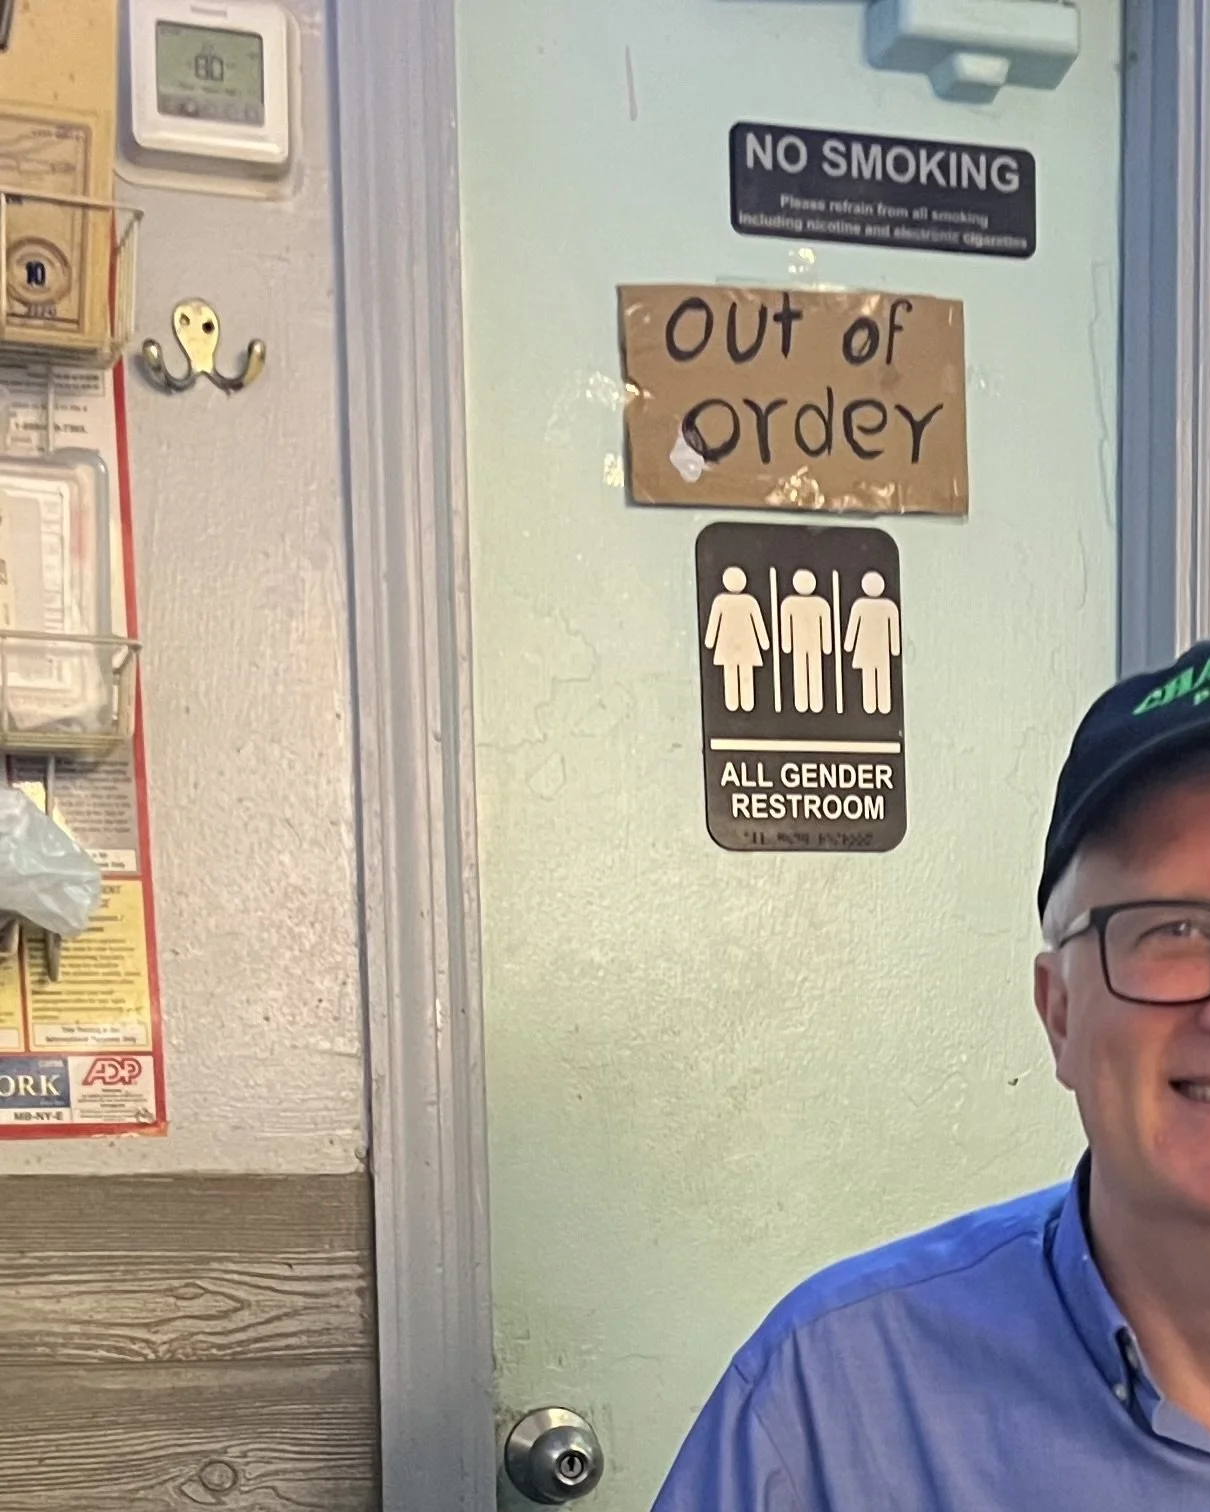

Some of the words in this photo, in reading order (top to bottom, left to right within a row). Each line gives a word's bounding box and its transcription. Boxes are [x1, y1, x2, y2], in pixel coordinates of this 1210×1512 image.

[745, 132, 808, 174] NO
[821, 138, 1020, 194] SMOKING
[780, 193, 826, 213] Please
[828, 199, 875, 216] refrain
[877, 202, 909, 219] from
[912, 207, 929, 221] all
[932, 209, 989, 231] smoking
[806, 216, 862, 237] nicotine
[864, 222, 891, 239] and
[893, 225, 961, 245] electronic
[962, 230, 1028, 250] cigarettes
[720, 761, 774, 788] ALL
[780, 762, 894, 790] GENDER
[731, 792, 886, 821] RESTROOM
[81, 1057, 142, 1086] ADP
